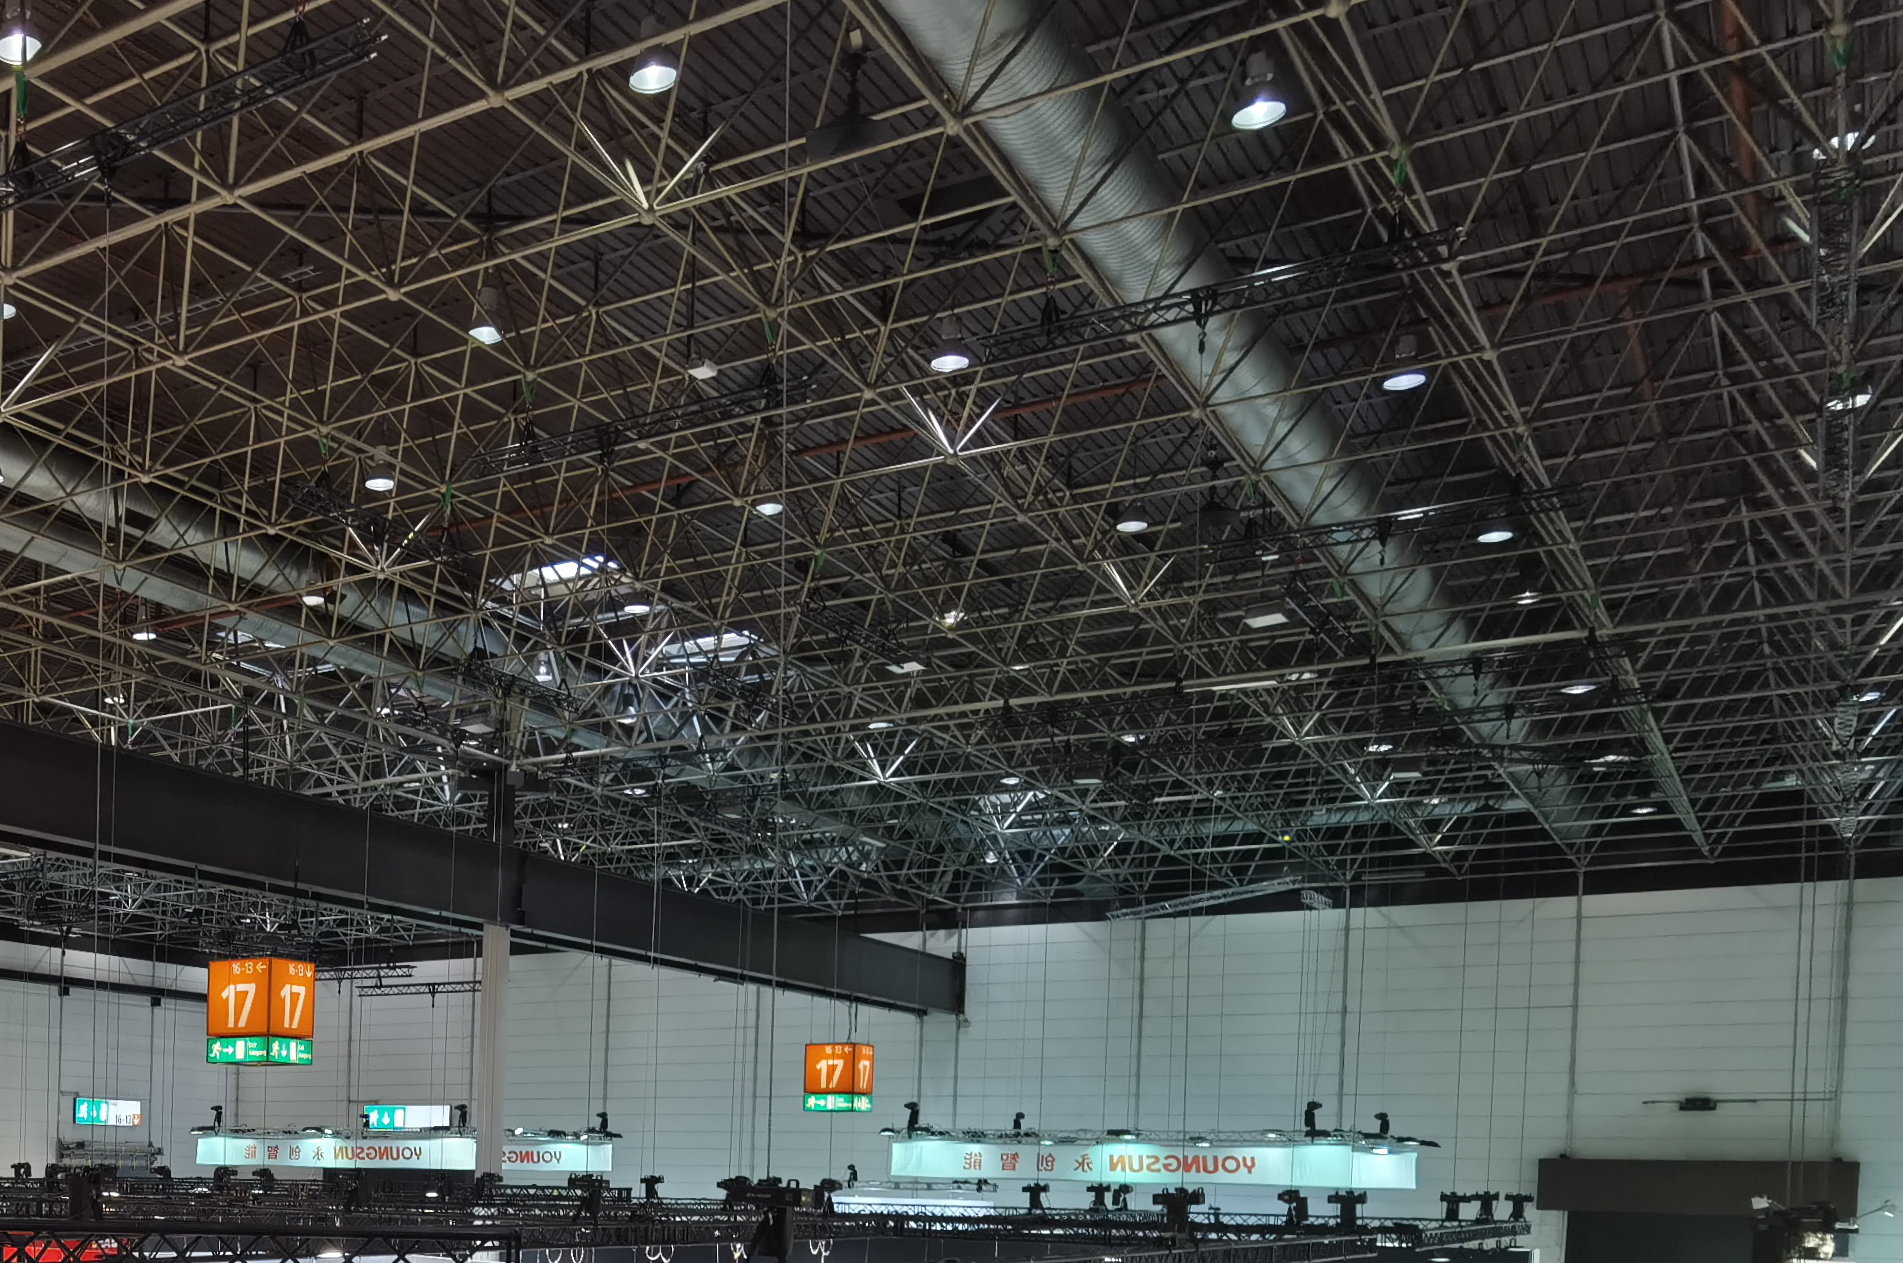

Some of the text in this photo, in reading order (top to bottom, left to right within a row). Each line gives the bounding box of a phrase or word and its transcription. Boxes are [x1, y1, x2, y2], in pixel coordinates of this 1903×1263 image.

[221, 983, 256, 1028] 17
[280, 984, 306, 1029] 17
[816, 1059, 844, 1089] 17
